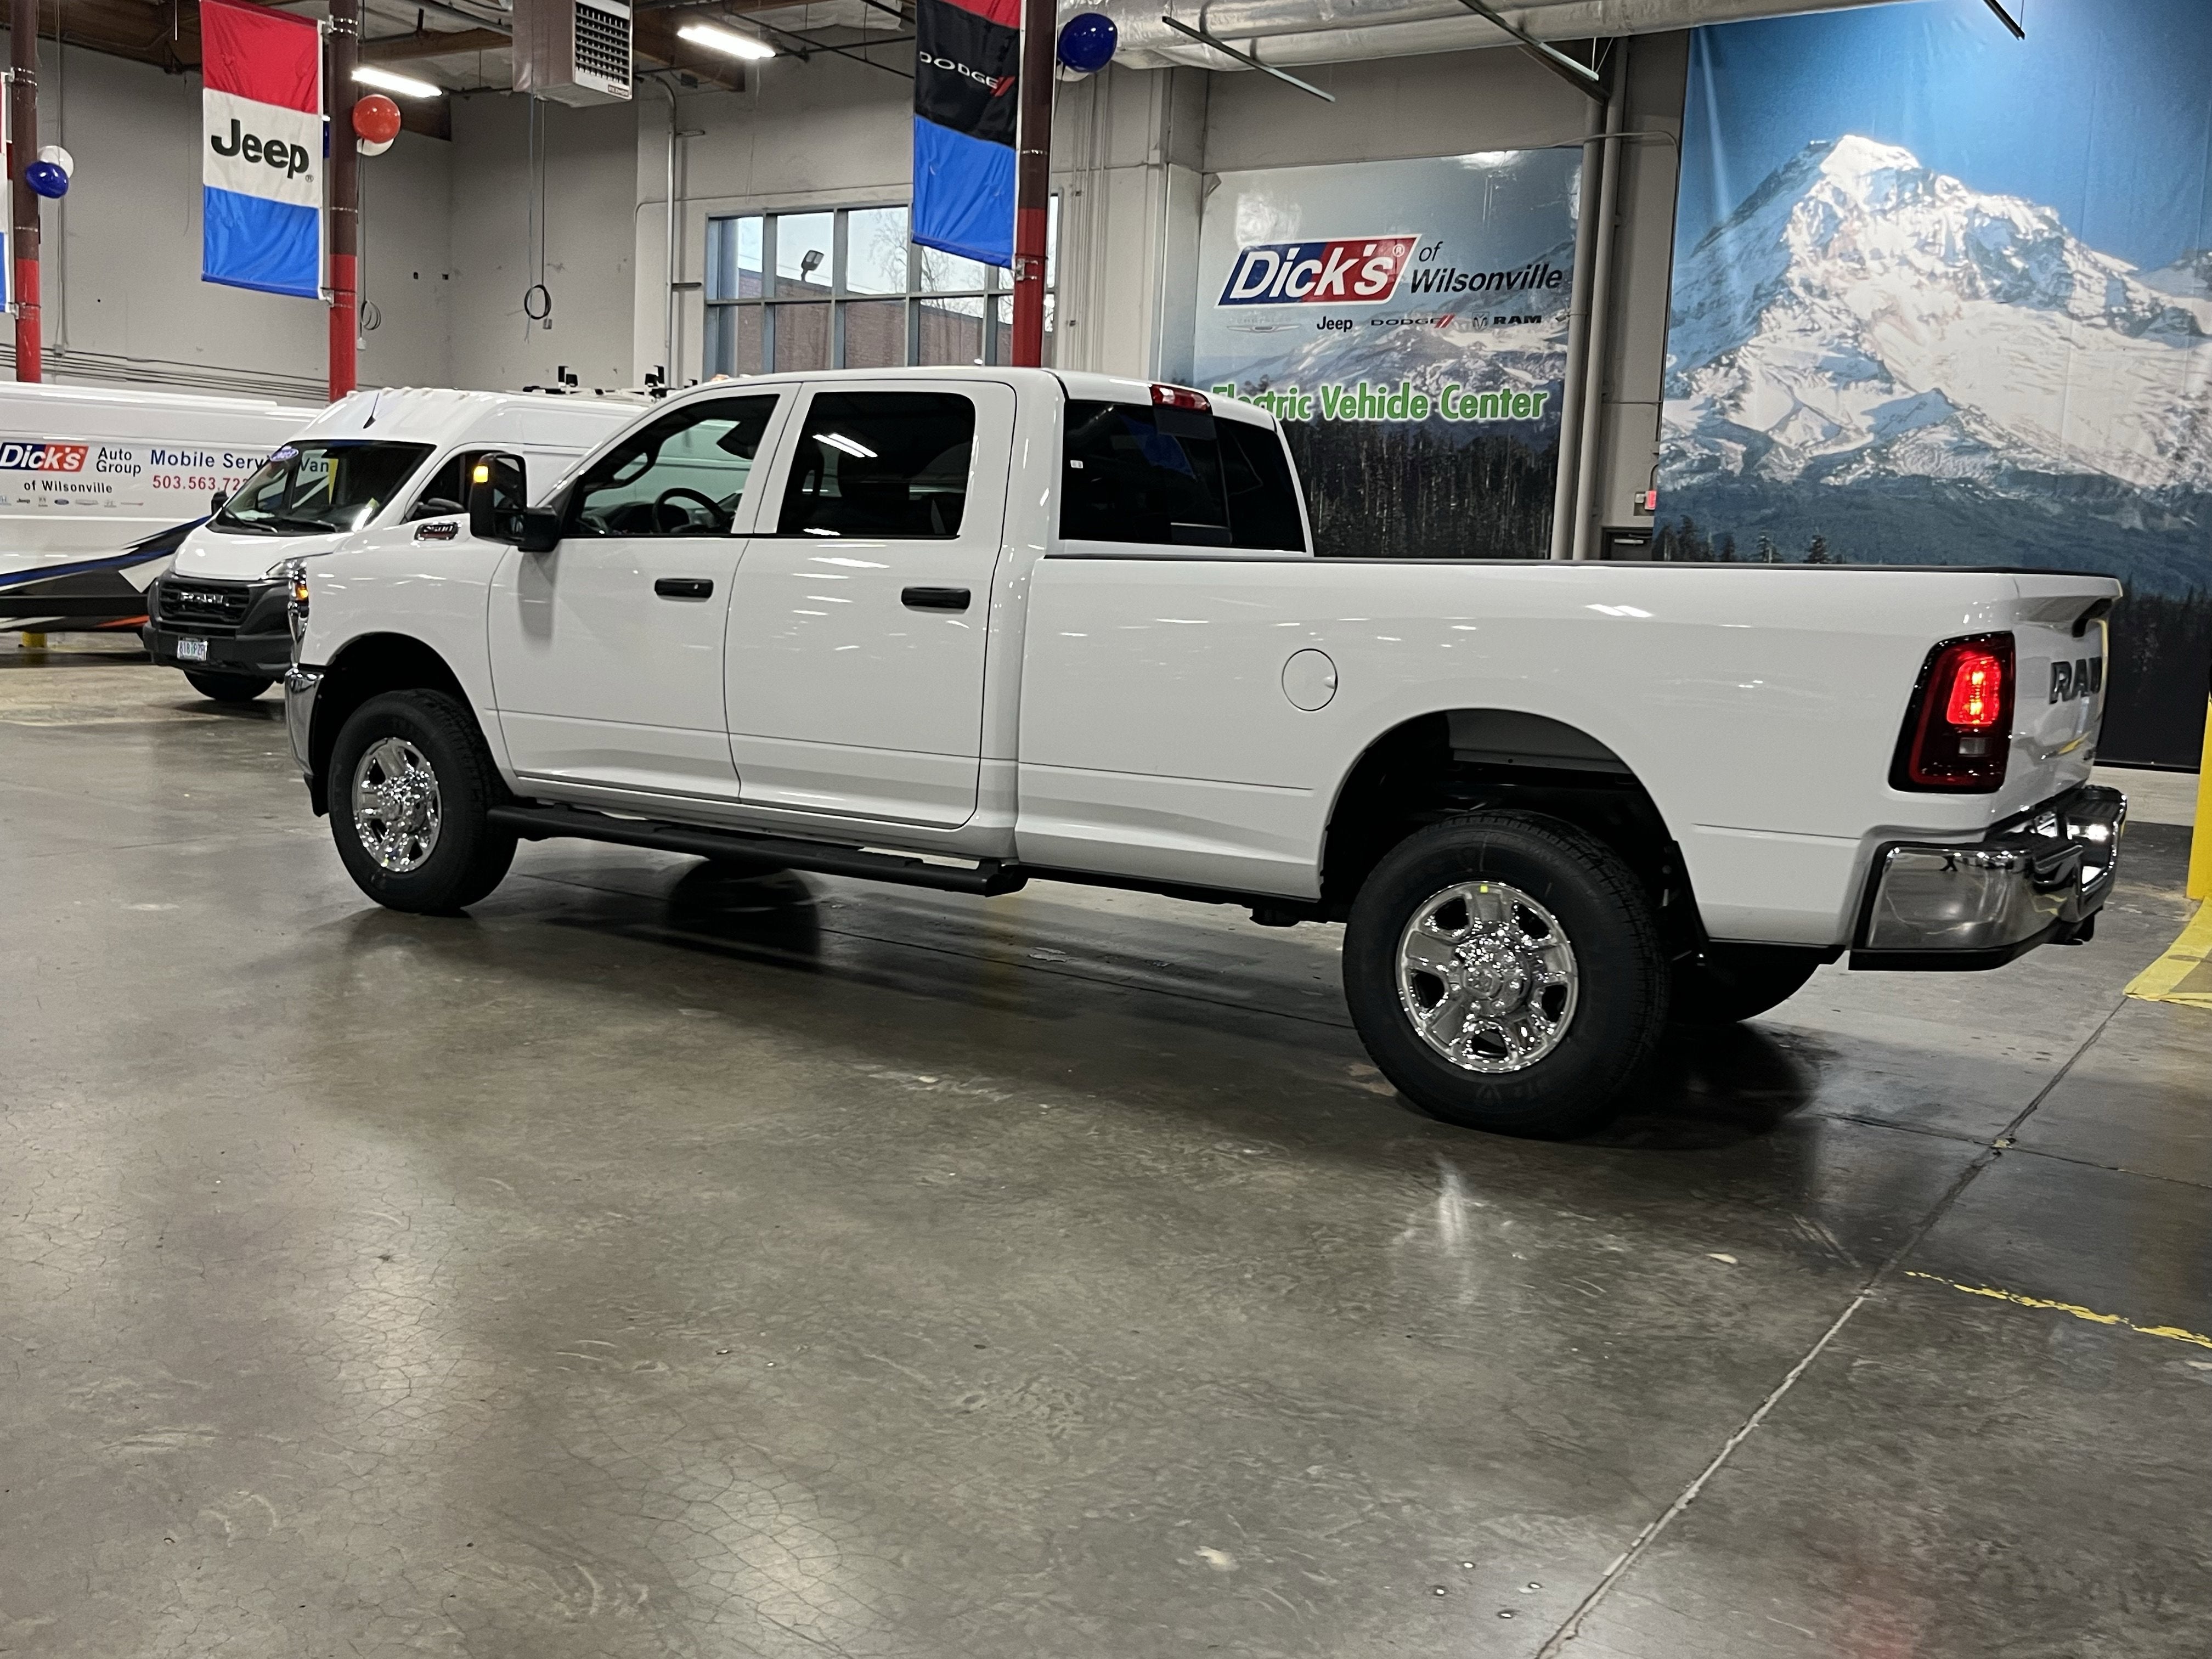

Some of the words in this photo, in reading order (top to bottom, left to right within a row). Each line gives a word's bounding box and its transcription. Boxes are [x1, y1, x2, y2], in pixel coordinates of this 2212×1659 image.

[919, 51, 998, 89] DODGE
[1419, 241, 1443, 262] of
[1410, 263, 1562, 294] Wilsonville
[1317, 315, 1353, 332] Jeep
[1493, 315, 1542, 325] RAM
[1212, 383, 1312, 419] ctric
[1322, 383, 1428, 419] Vehicle
[1441, 385, 1547, 419] Center
[98, 447, 132, 460] Auto
[150, 449, 215, 467] Mobile
[223, 453, 270, 470] Serv
[300, 457, 329, 472] Van
[96, 460, 141, 477] Group
[24, 479, 36, 490] of
[42, 480, 112, 493] Wilsonville
